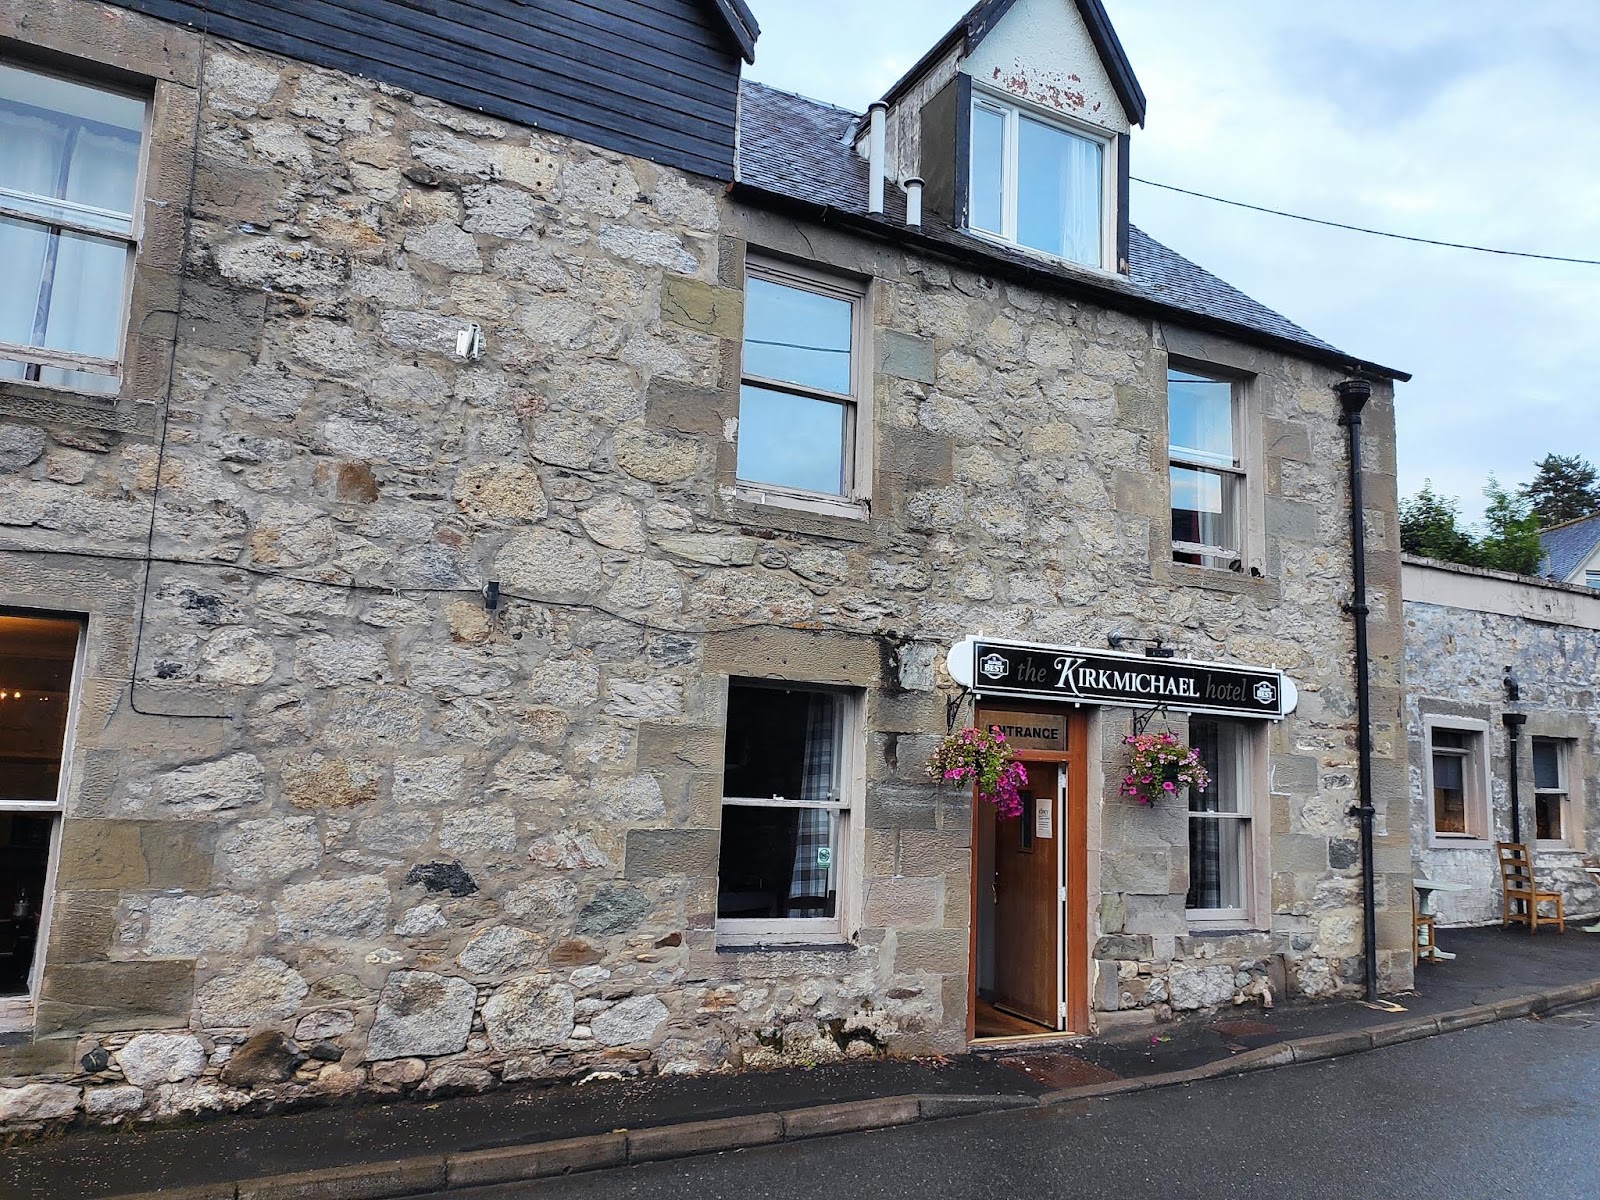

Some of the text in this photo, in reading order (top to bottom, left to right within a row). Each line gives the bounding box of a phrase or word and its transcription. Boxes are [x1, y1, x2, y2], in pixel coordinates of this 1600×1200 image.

[984, 663, 1005, 673] BEST
[1017, 656, 1248, 702] the KIRKMICHAEL hotel
[1256, 689, 1274, 699] BEST
